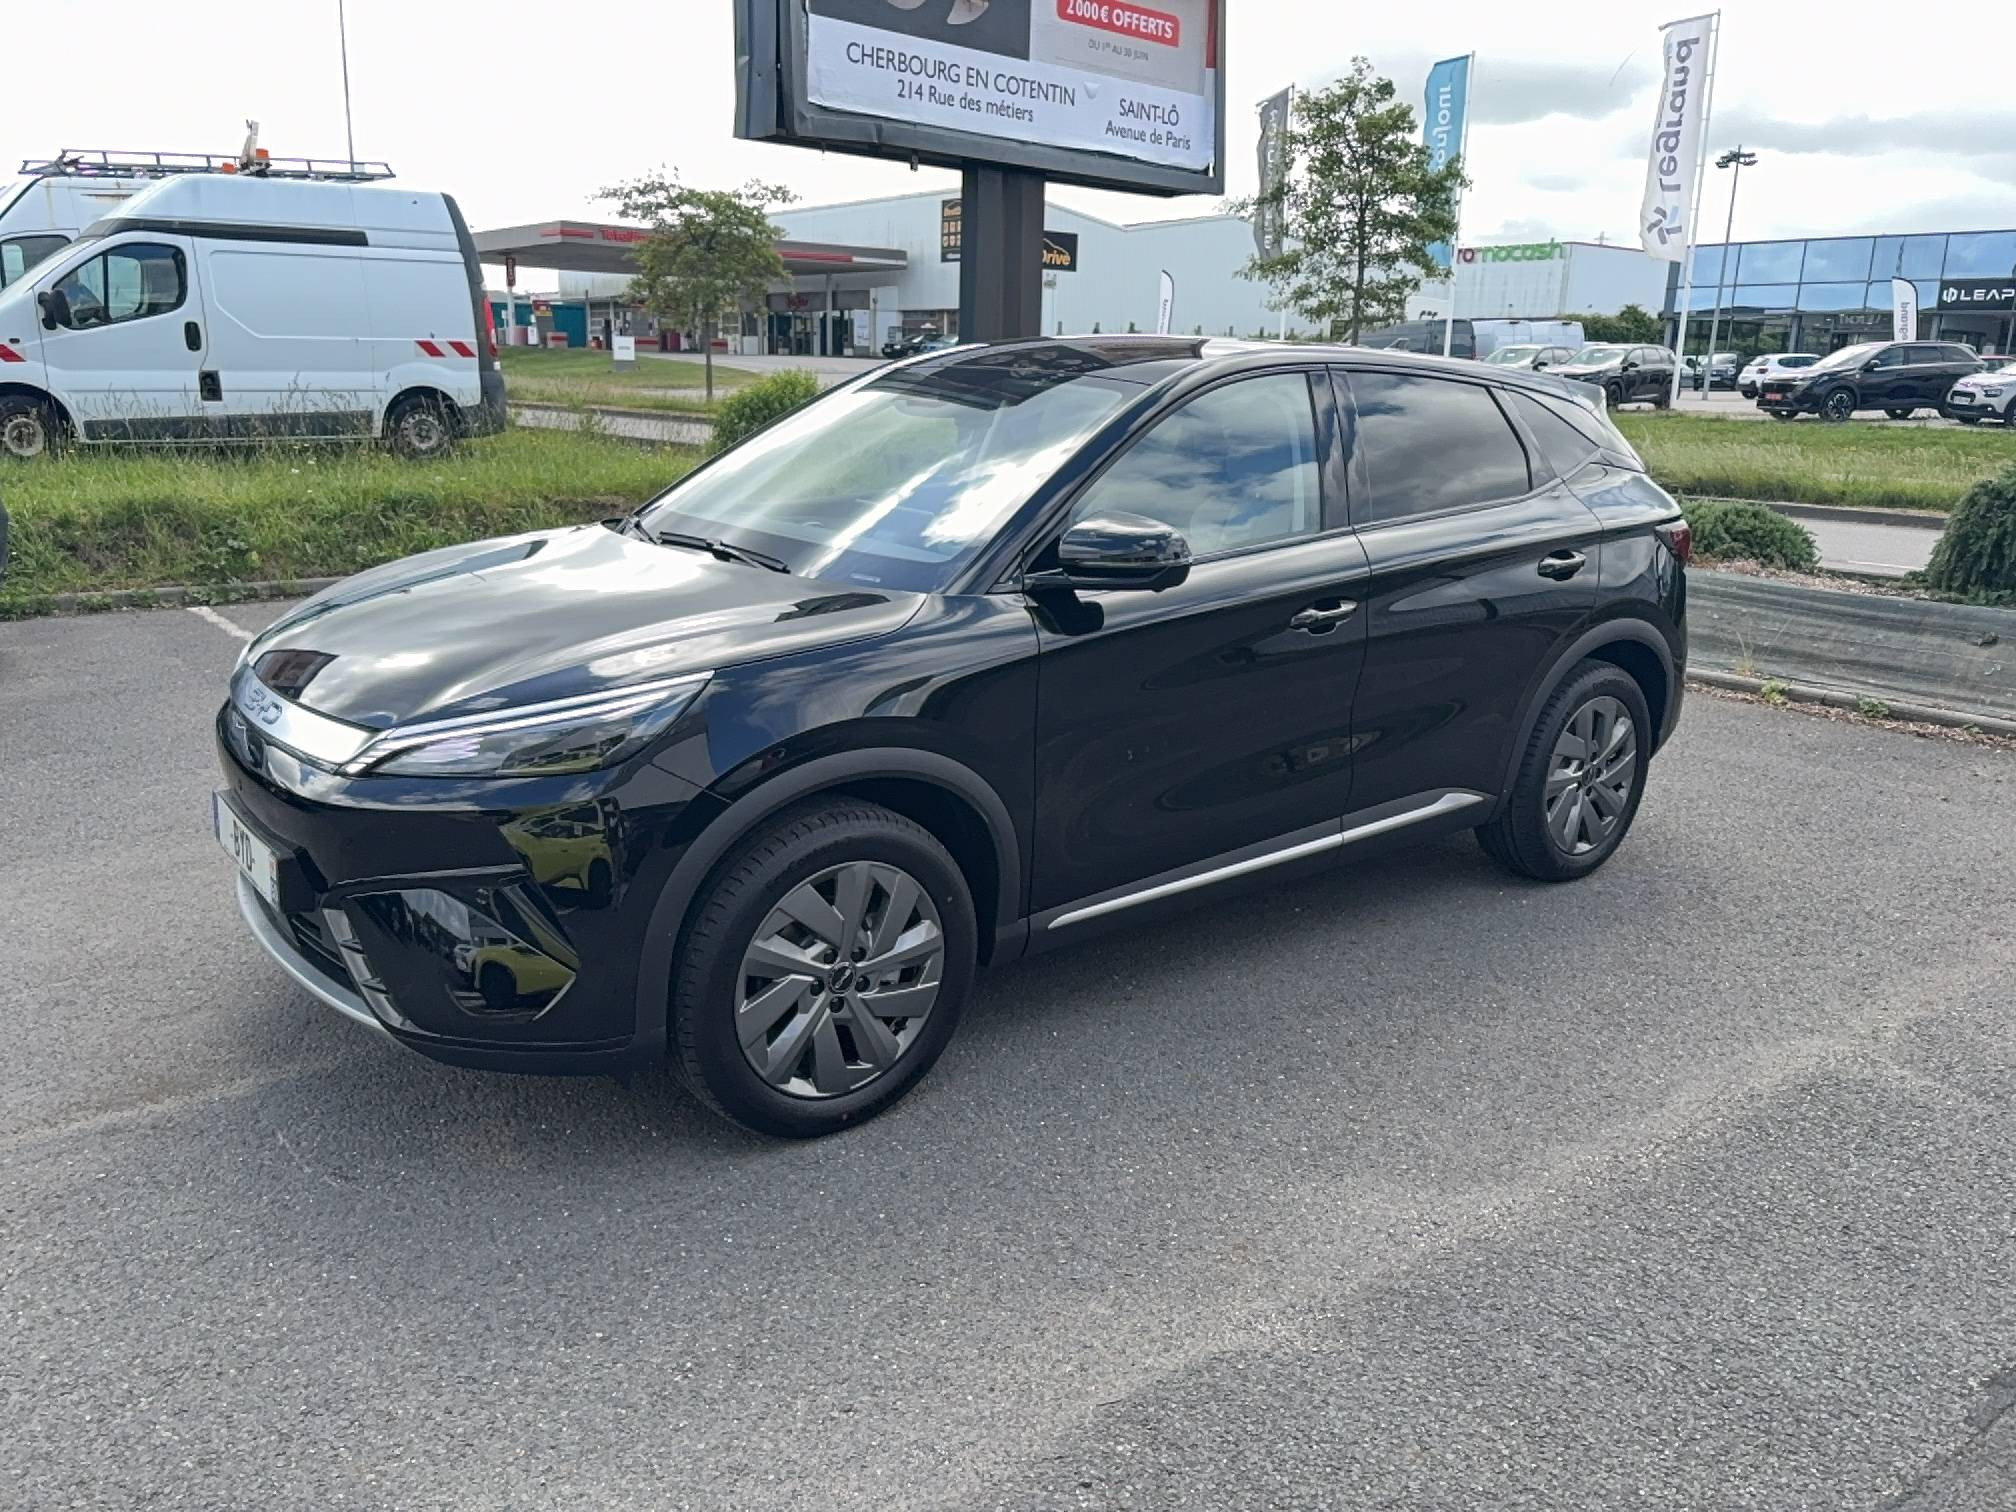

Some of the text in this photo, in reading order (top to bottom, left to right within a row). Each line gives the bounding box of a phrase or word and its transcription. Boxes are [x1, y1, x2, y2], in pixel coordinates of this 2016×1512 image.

[1112, 9, 1174, 39] OFFERTS
[846, 42, 1076, 107] CHERBOURG EN COTENTIN
[897, 79, 1034, 122] 214 Rue des métiers
[1119, 98, 1180, 127] SAINT-LÔ
[1105, 120, 1191, 150] Avenue de Paris
[1960, 288, 2015, 301] LEAP
